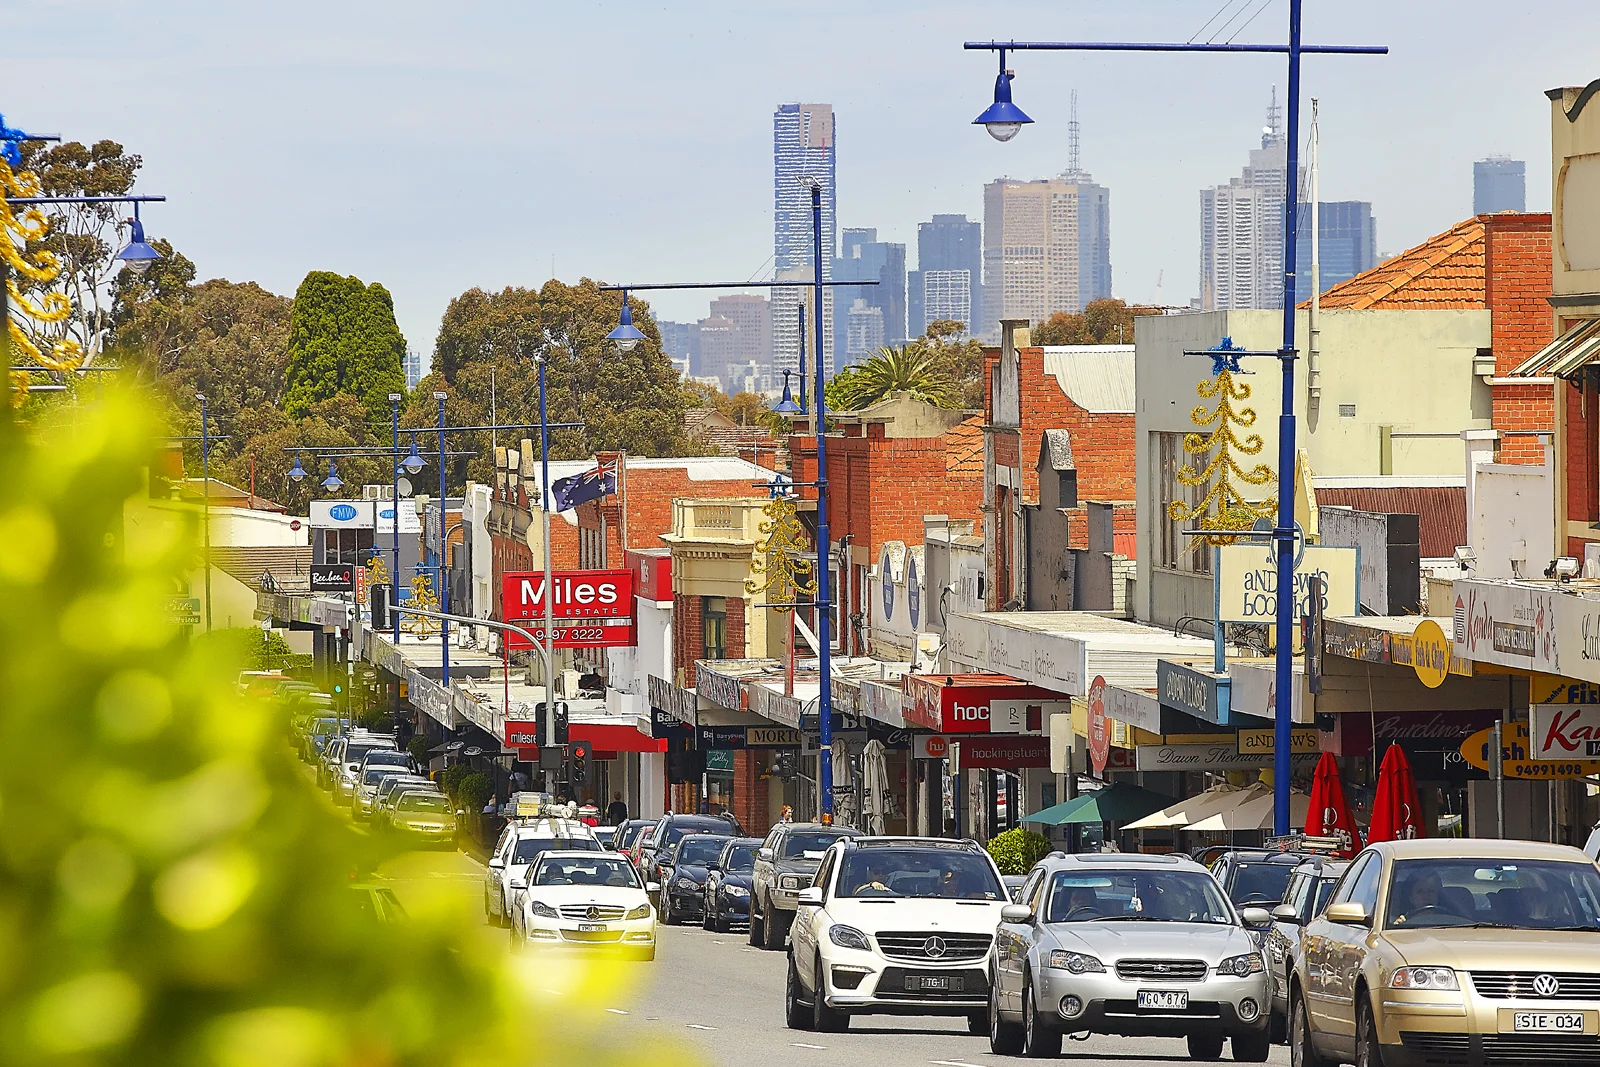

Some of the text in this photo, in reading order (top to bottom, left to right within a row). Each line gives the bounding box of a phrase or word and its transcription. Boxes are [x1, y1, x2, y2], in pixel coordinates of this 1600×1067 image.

[331, 507, 354, 518] FMW
[521, 578, 617, 605] Miles
[522, 608, 618, 617] REA ESTATE
[535, 629, 604, 641] 997 3222
[1540, 684, 1566, 703] vanhoe
[953, 702, 990, 721] hoc
[971, 747, 1048, 760] hockingstuart
[1156, 748, 1200, 764] Dawn
[1482, 742, 1524, 760] fsh
[1515, 764, 1582, 776] 94991498
[1138, 992, 1186, 1005] WGQ 876
